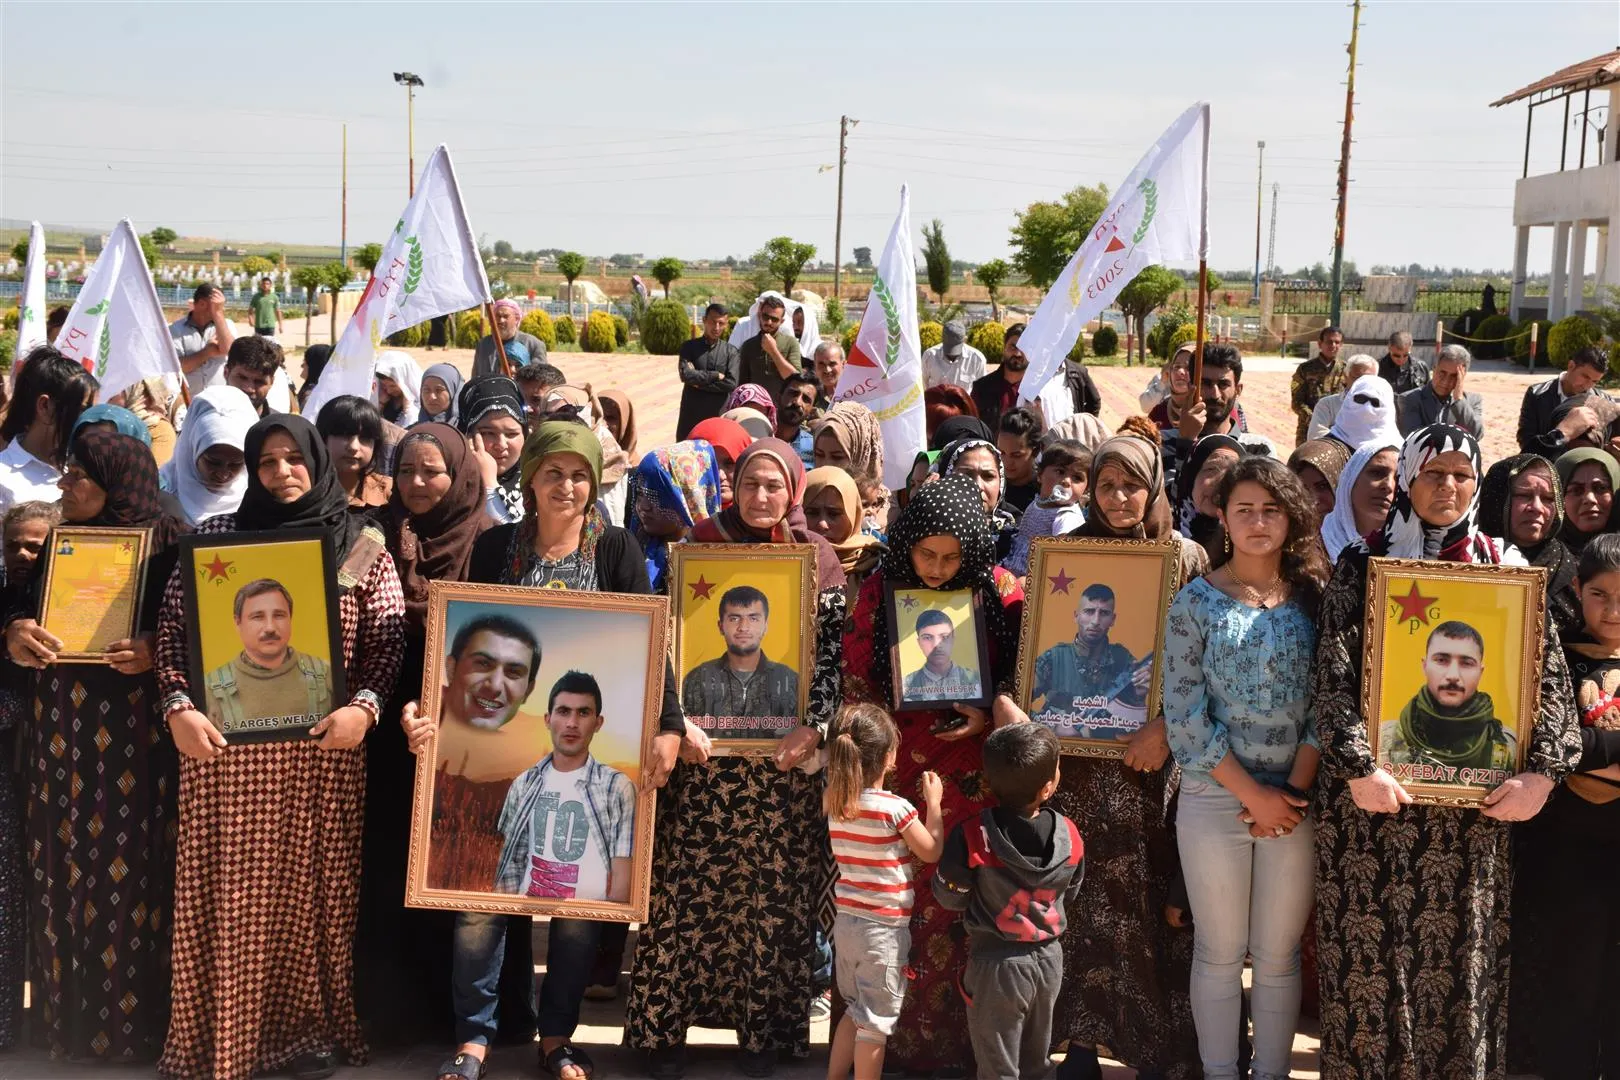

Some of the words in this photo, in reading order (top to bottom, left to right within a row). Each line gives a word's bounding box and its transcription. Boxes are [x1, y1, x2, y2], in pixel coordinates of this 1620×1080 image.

[1072, 694, 1108, 710] الشهيد
[281, 713, 323, 725] WELAT
[717, 715, 760, 729] BERZAN
[1062, 712, 1084, 728] حاج
